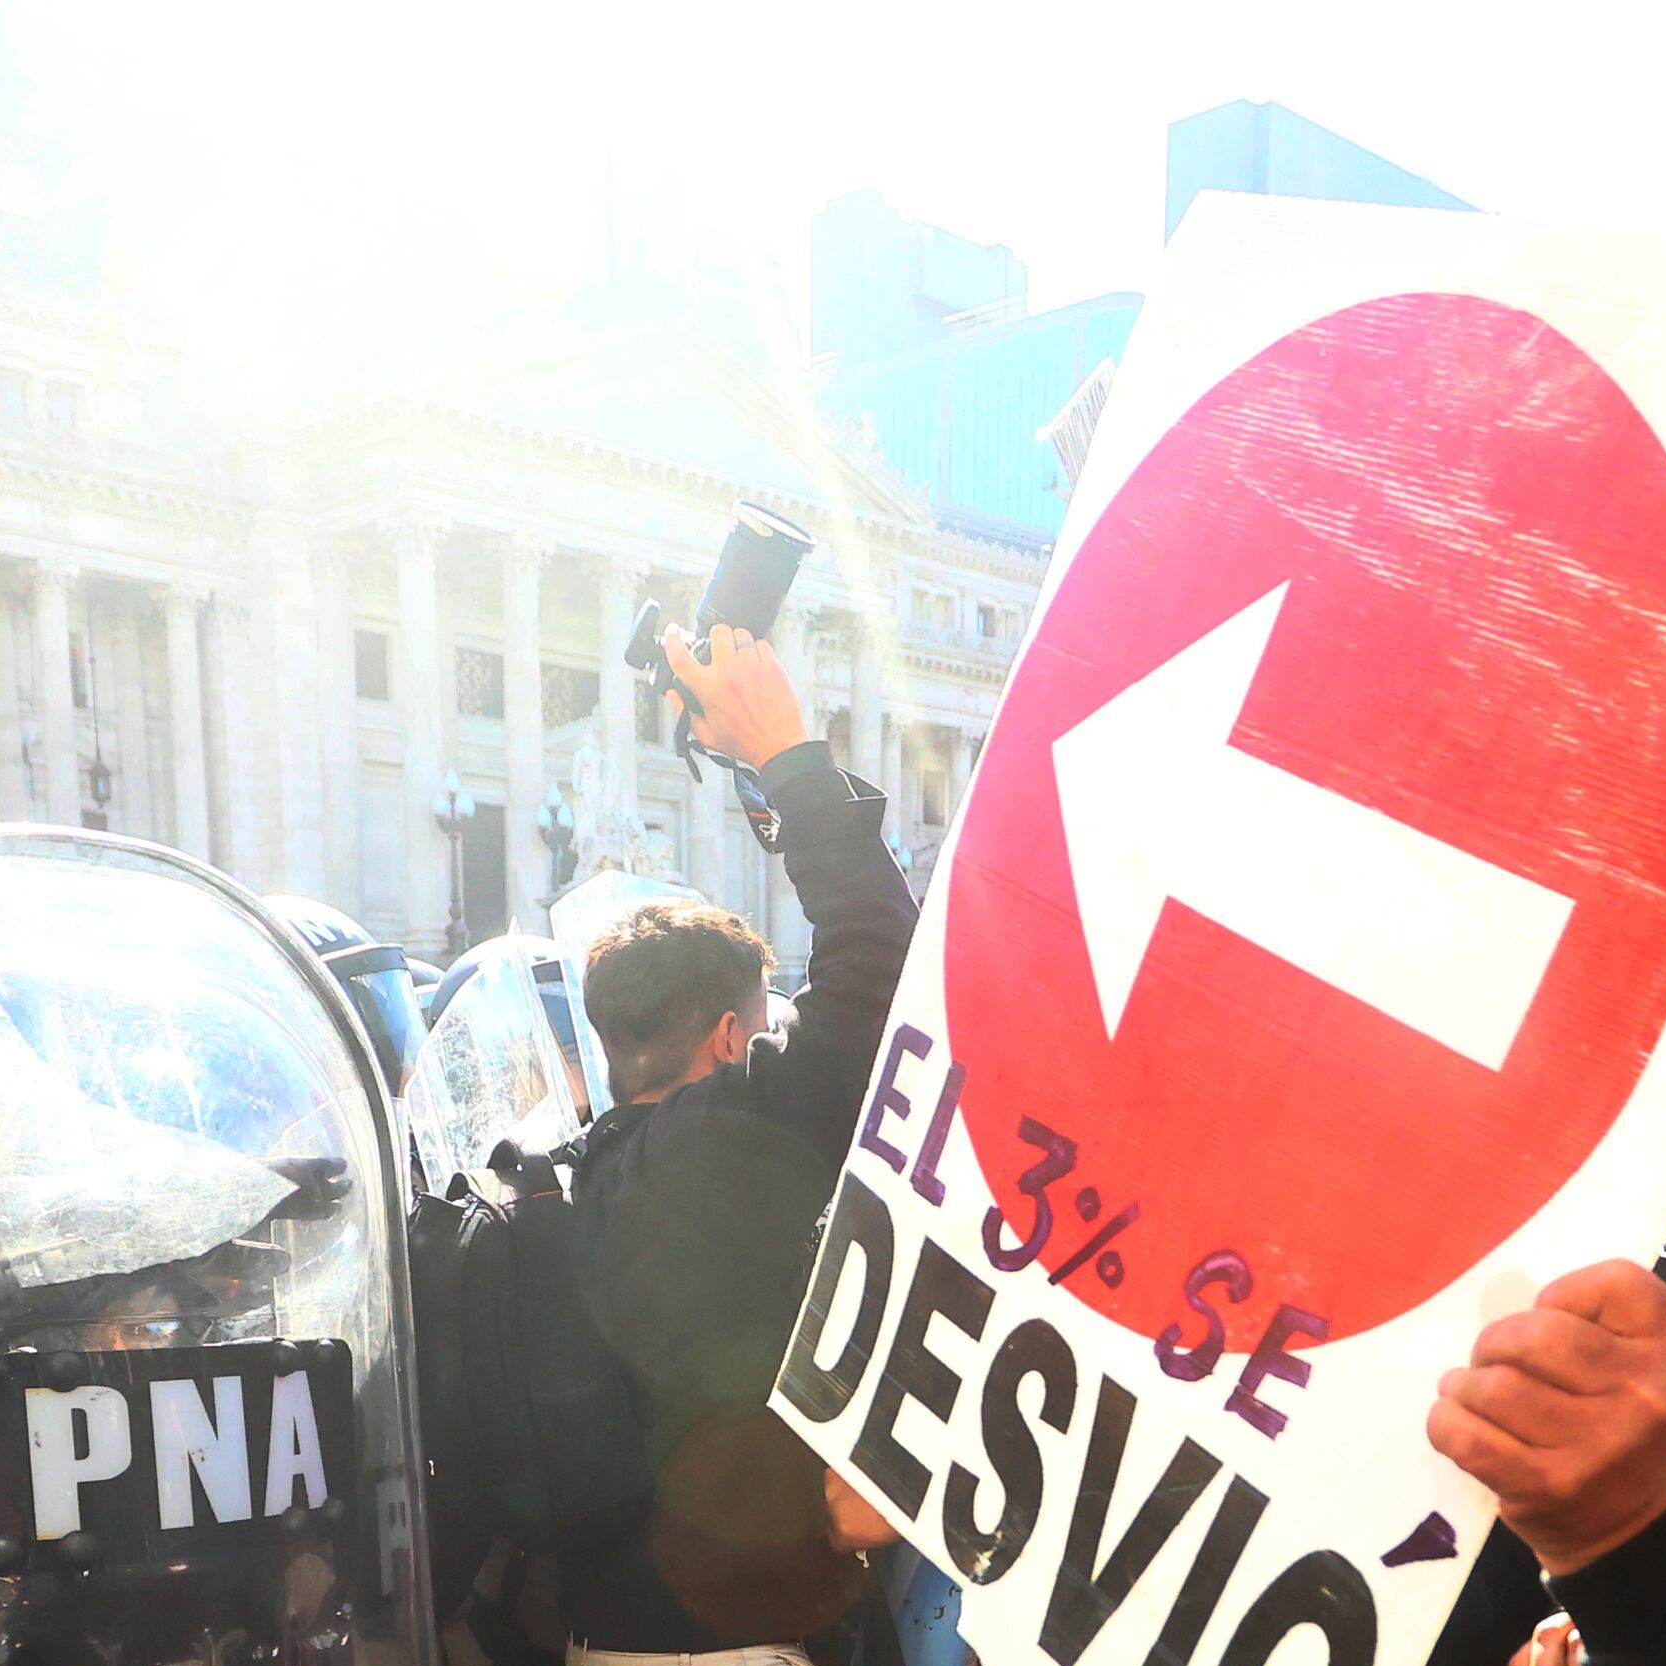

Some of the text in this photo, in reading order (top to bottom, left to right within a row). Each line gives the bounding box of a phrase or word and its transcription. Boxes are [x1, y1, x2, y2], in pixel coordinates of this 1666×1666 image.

[859, 1022, 1330, 1441] EL 3% SE
[23, 1370, 330, 1541] PNA
